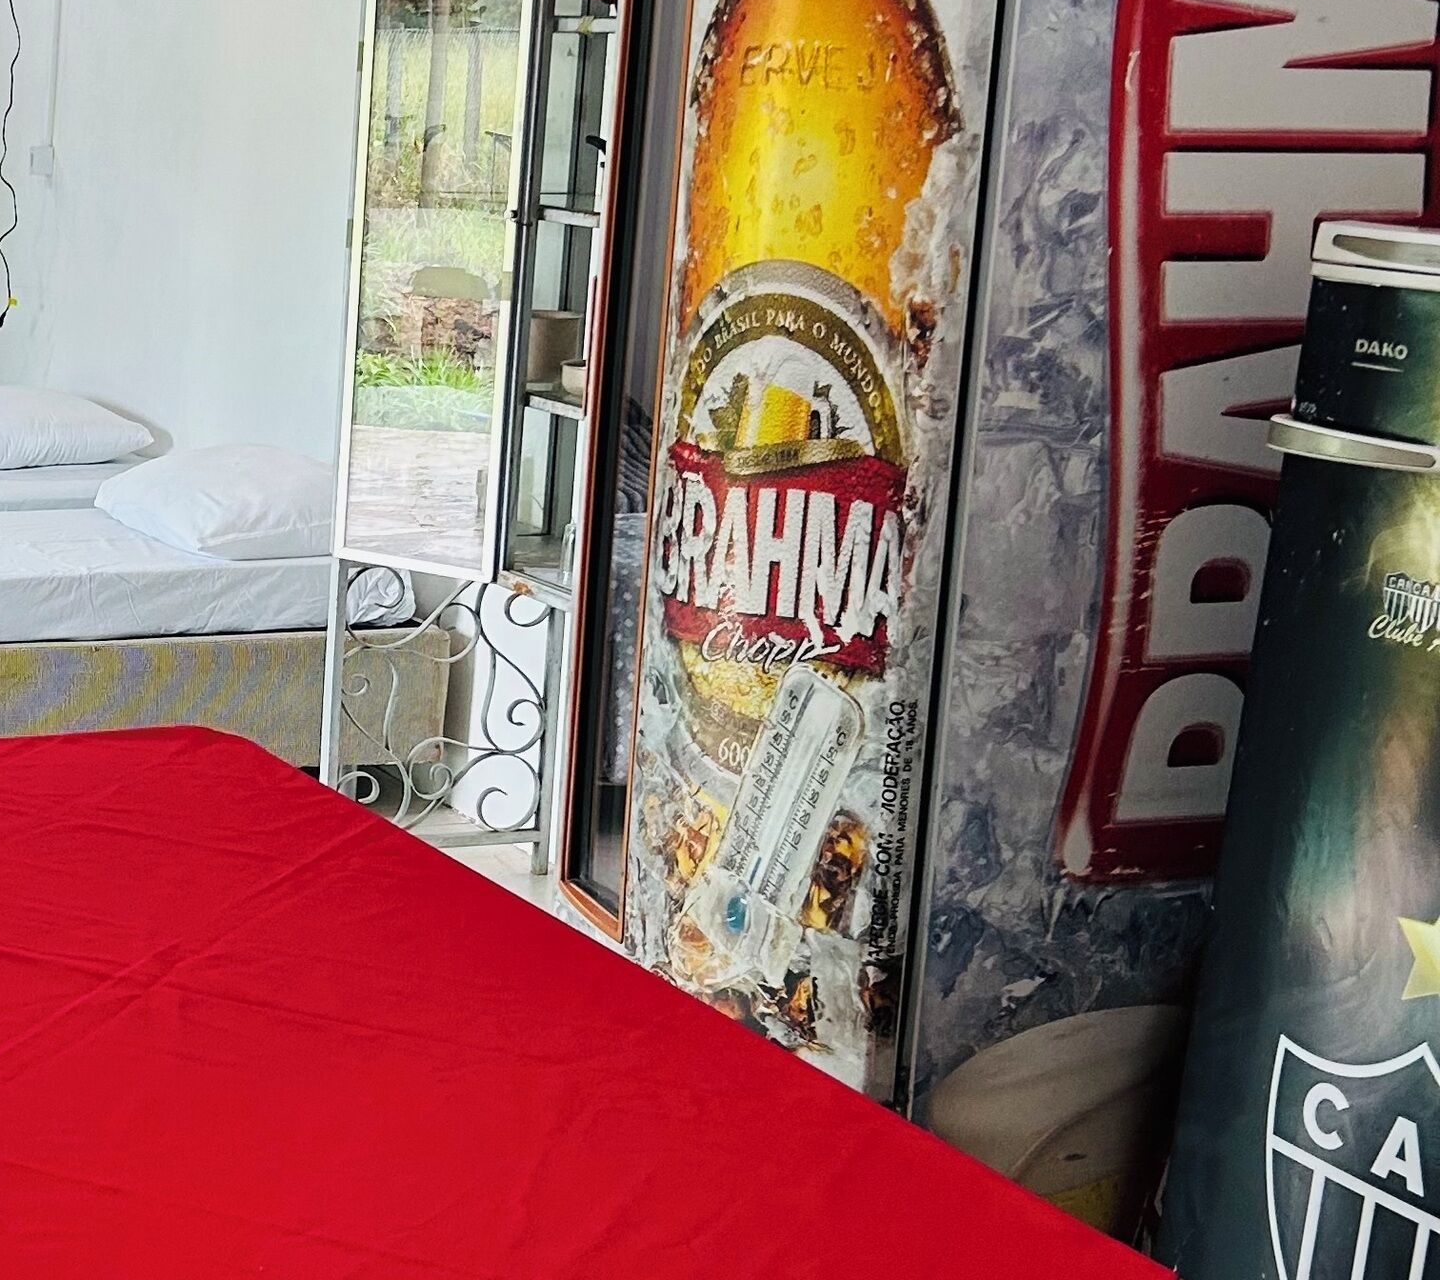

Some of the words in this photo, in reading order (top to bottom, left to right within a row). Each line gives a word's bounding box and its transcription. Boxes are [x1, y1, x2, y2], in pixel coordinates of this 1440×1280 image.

[714, 310, 761, 349] BRASIL
[766, 308, 805, 333] PARA
[812, 322, 826, 340] O
[829, 332, 882, 408] MUNDO
[1354, 338, 1409, 360] DAKO
[660, 471, 904, 638] BRAHMA
[1368, 614, 1424, 647] Clube
[702, 621, 842, 674] Chopp
[905, 739, 914, 752] 18
[902, 757, 913, 773] DE
[897, 777, 911, 832] MENORES
[886, 925, 898, 957] ENDA
